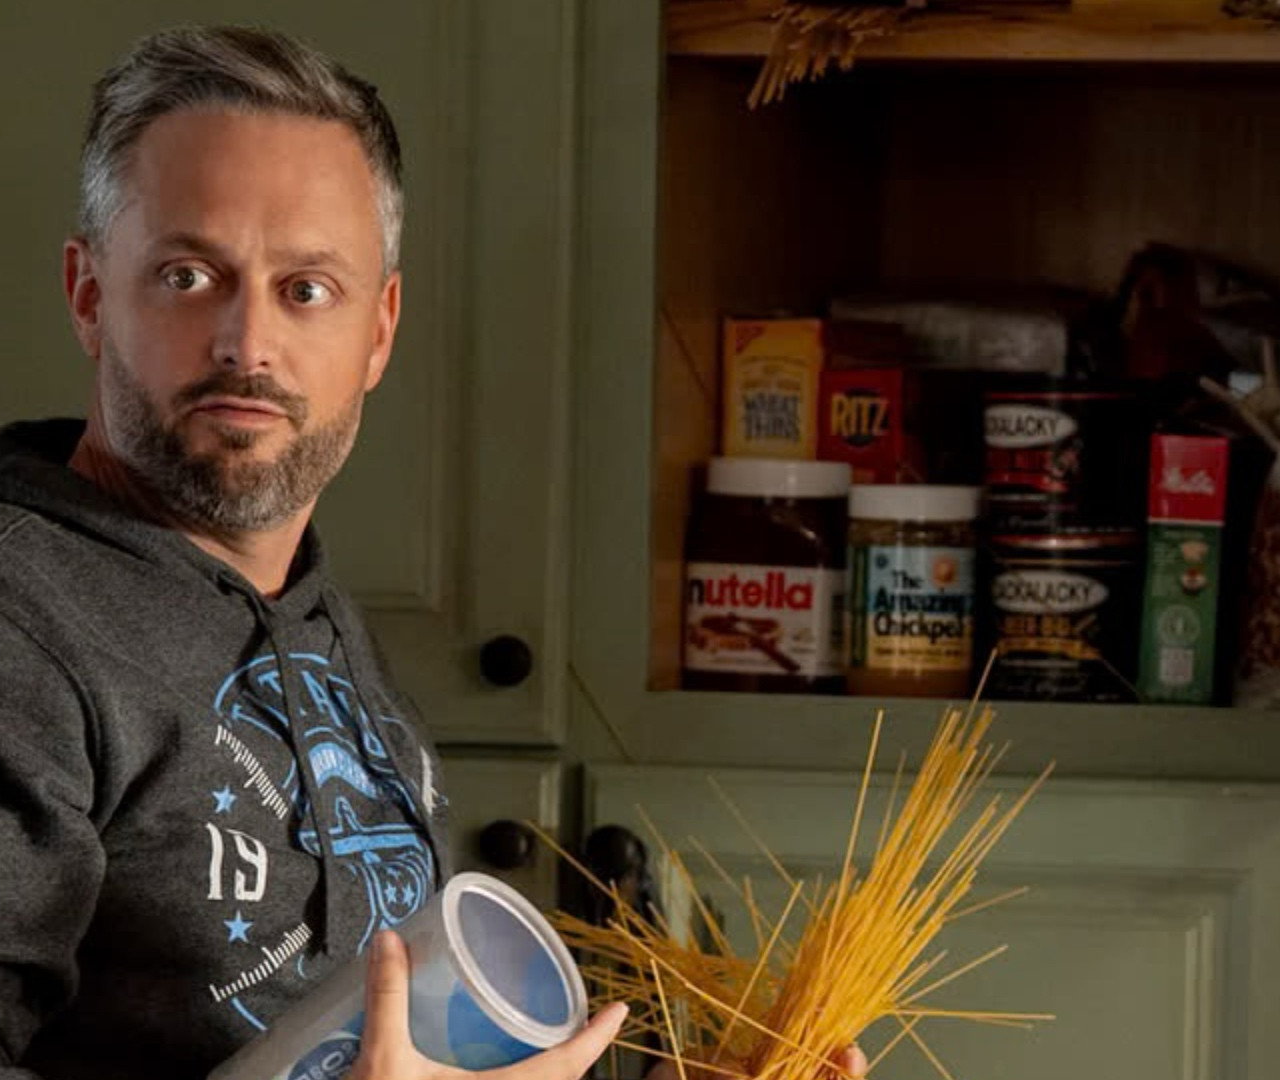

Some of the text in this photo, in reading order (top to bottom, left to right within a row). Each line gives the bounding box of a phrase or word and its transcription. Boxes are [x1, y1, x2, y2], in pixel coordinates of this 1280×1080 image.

[831, 394, 889, 438] RITZ
[689, 571, 814, 610] nutella
[205, 823, 269, 902] 19
